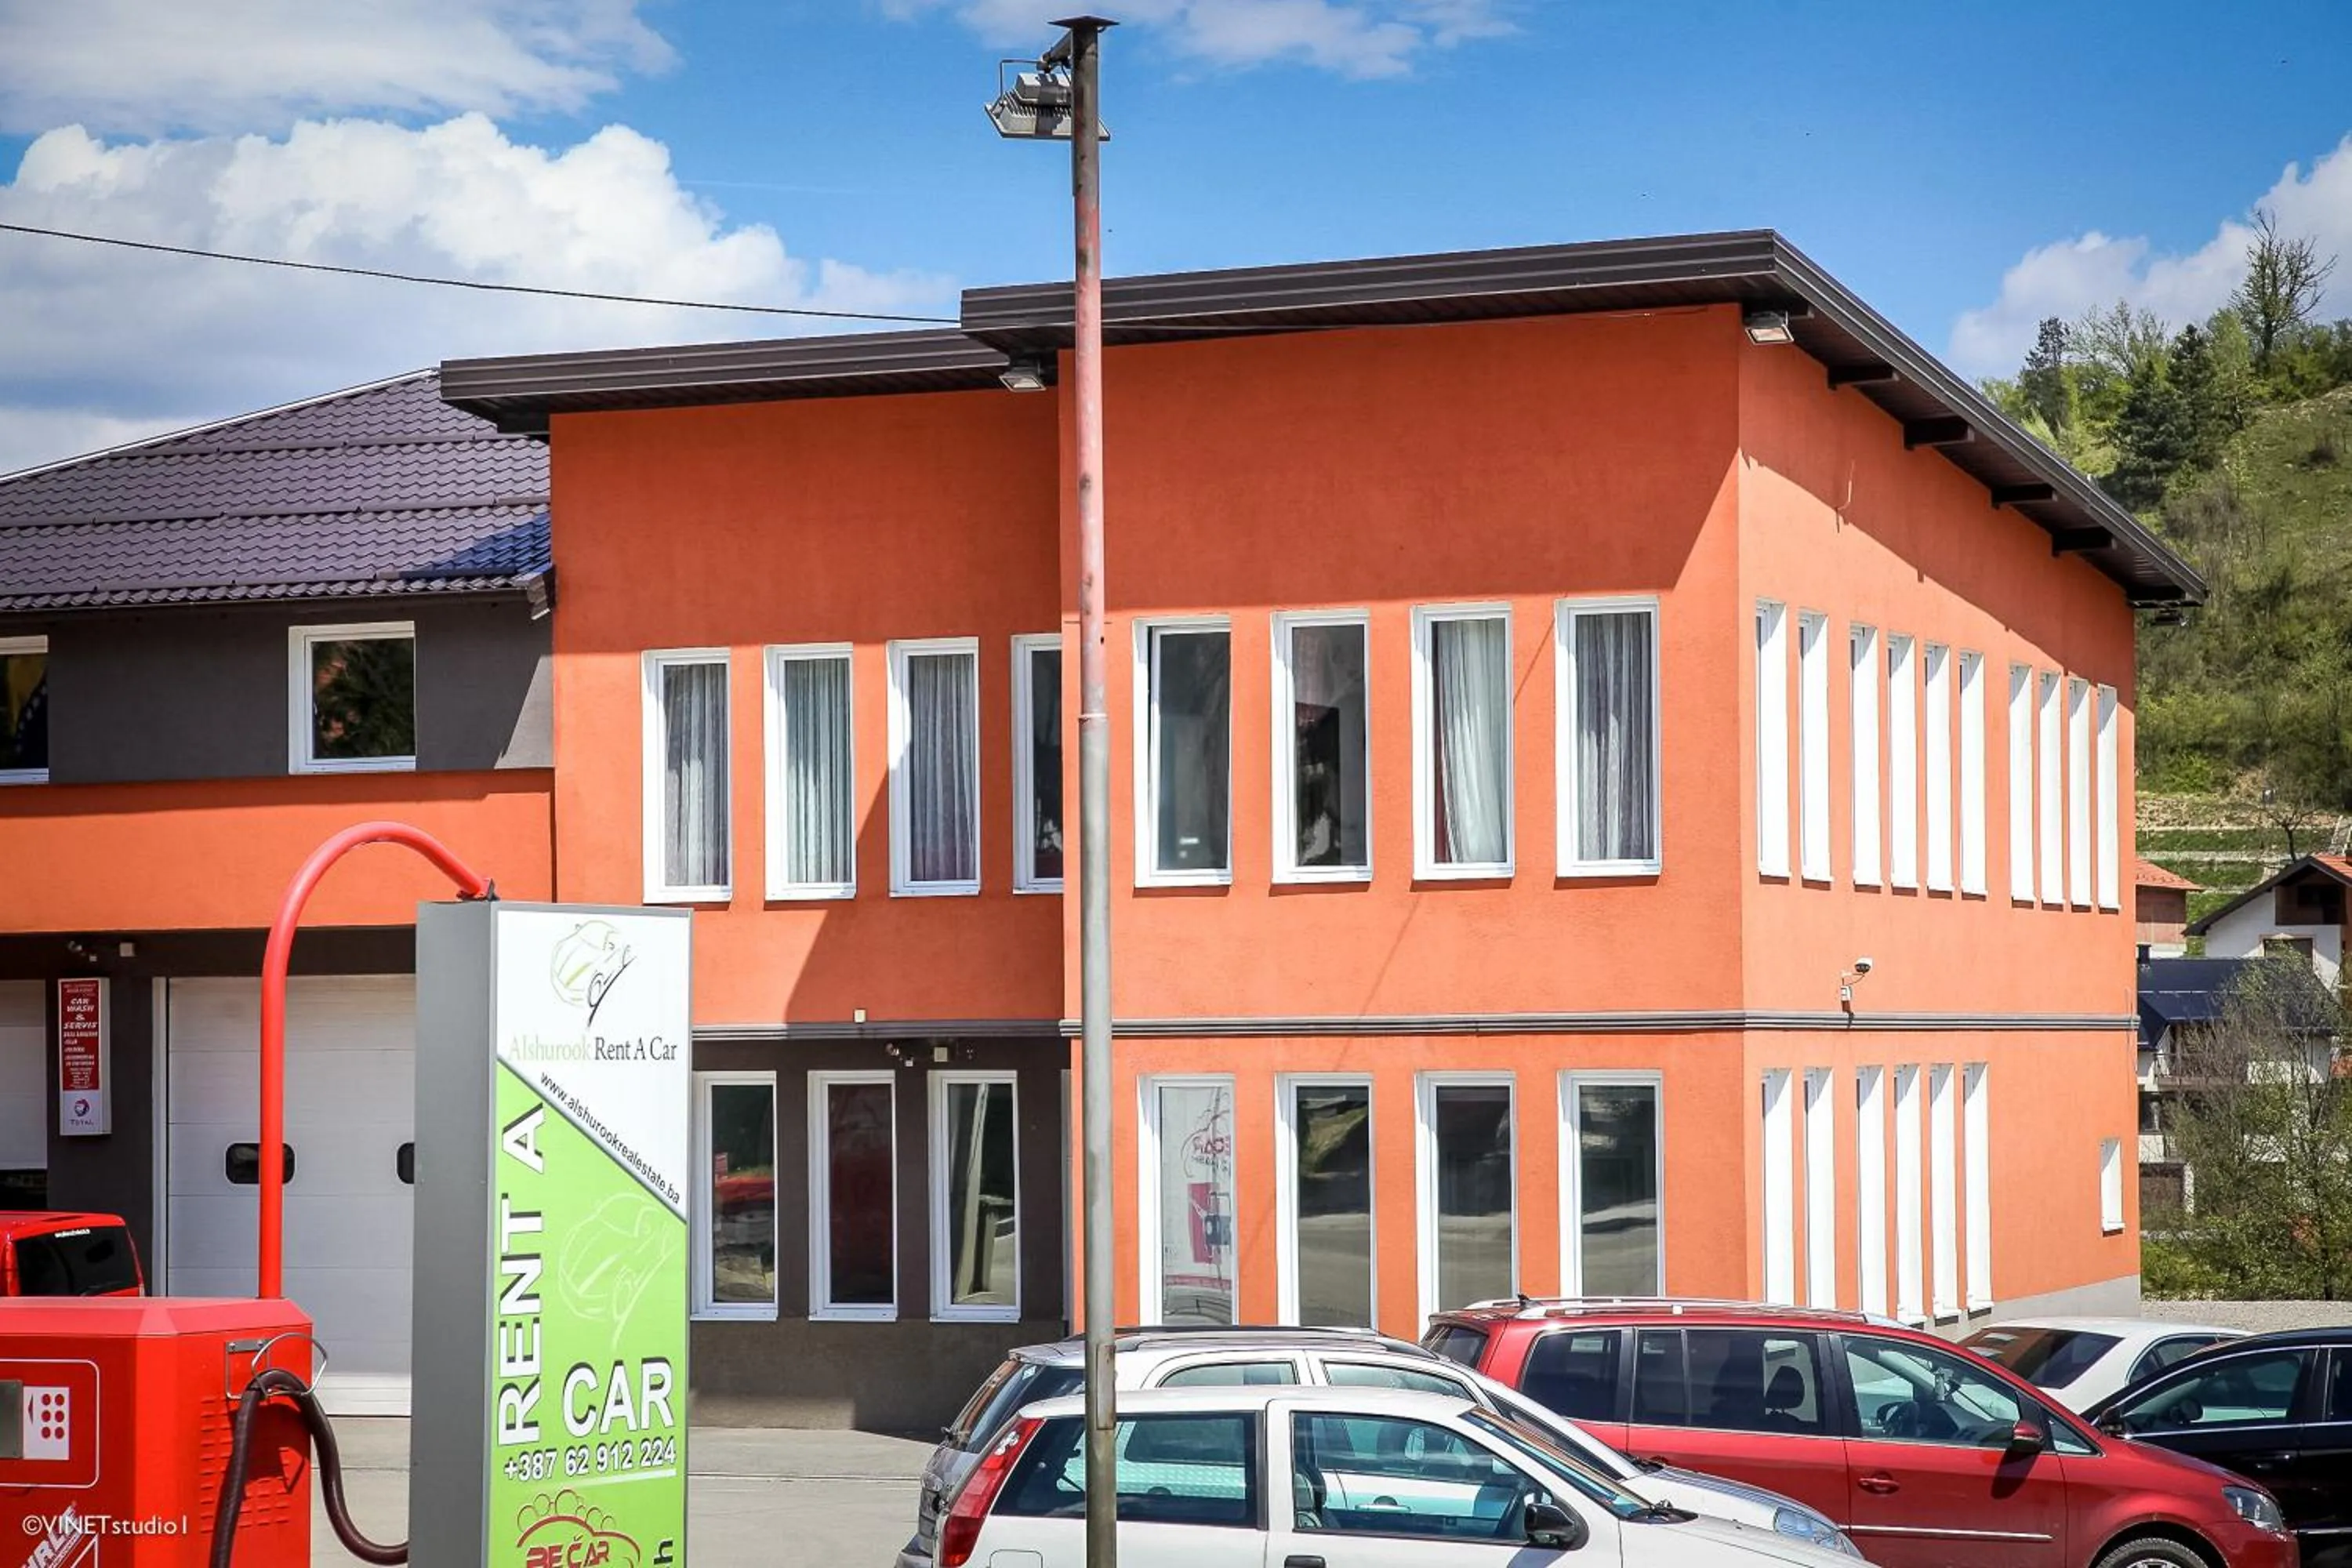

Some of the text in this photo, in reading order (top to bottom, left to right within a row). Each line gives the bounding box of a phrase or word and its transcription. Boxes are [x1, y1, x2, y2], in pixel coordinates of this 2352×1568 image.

[509, 1035, 677, 1060] Alshurook Rent A Car
[540, 1072, 681, 1205] www.alshurookrealestate.ba
[497, 1102, 546, 1446] RENT A
[562, 1356, 675, 1438] CAR
[504, 1436, 676, 1481] +387 62 912 224
